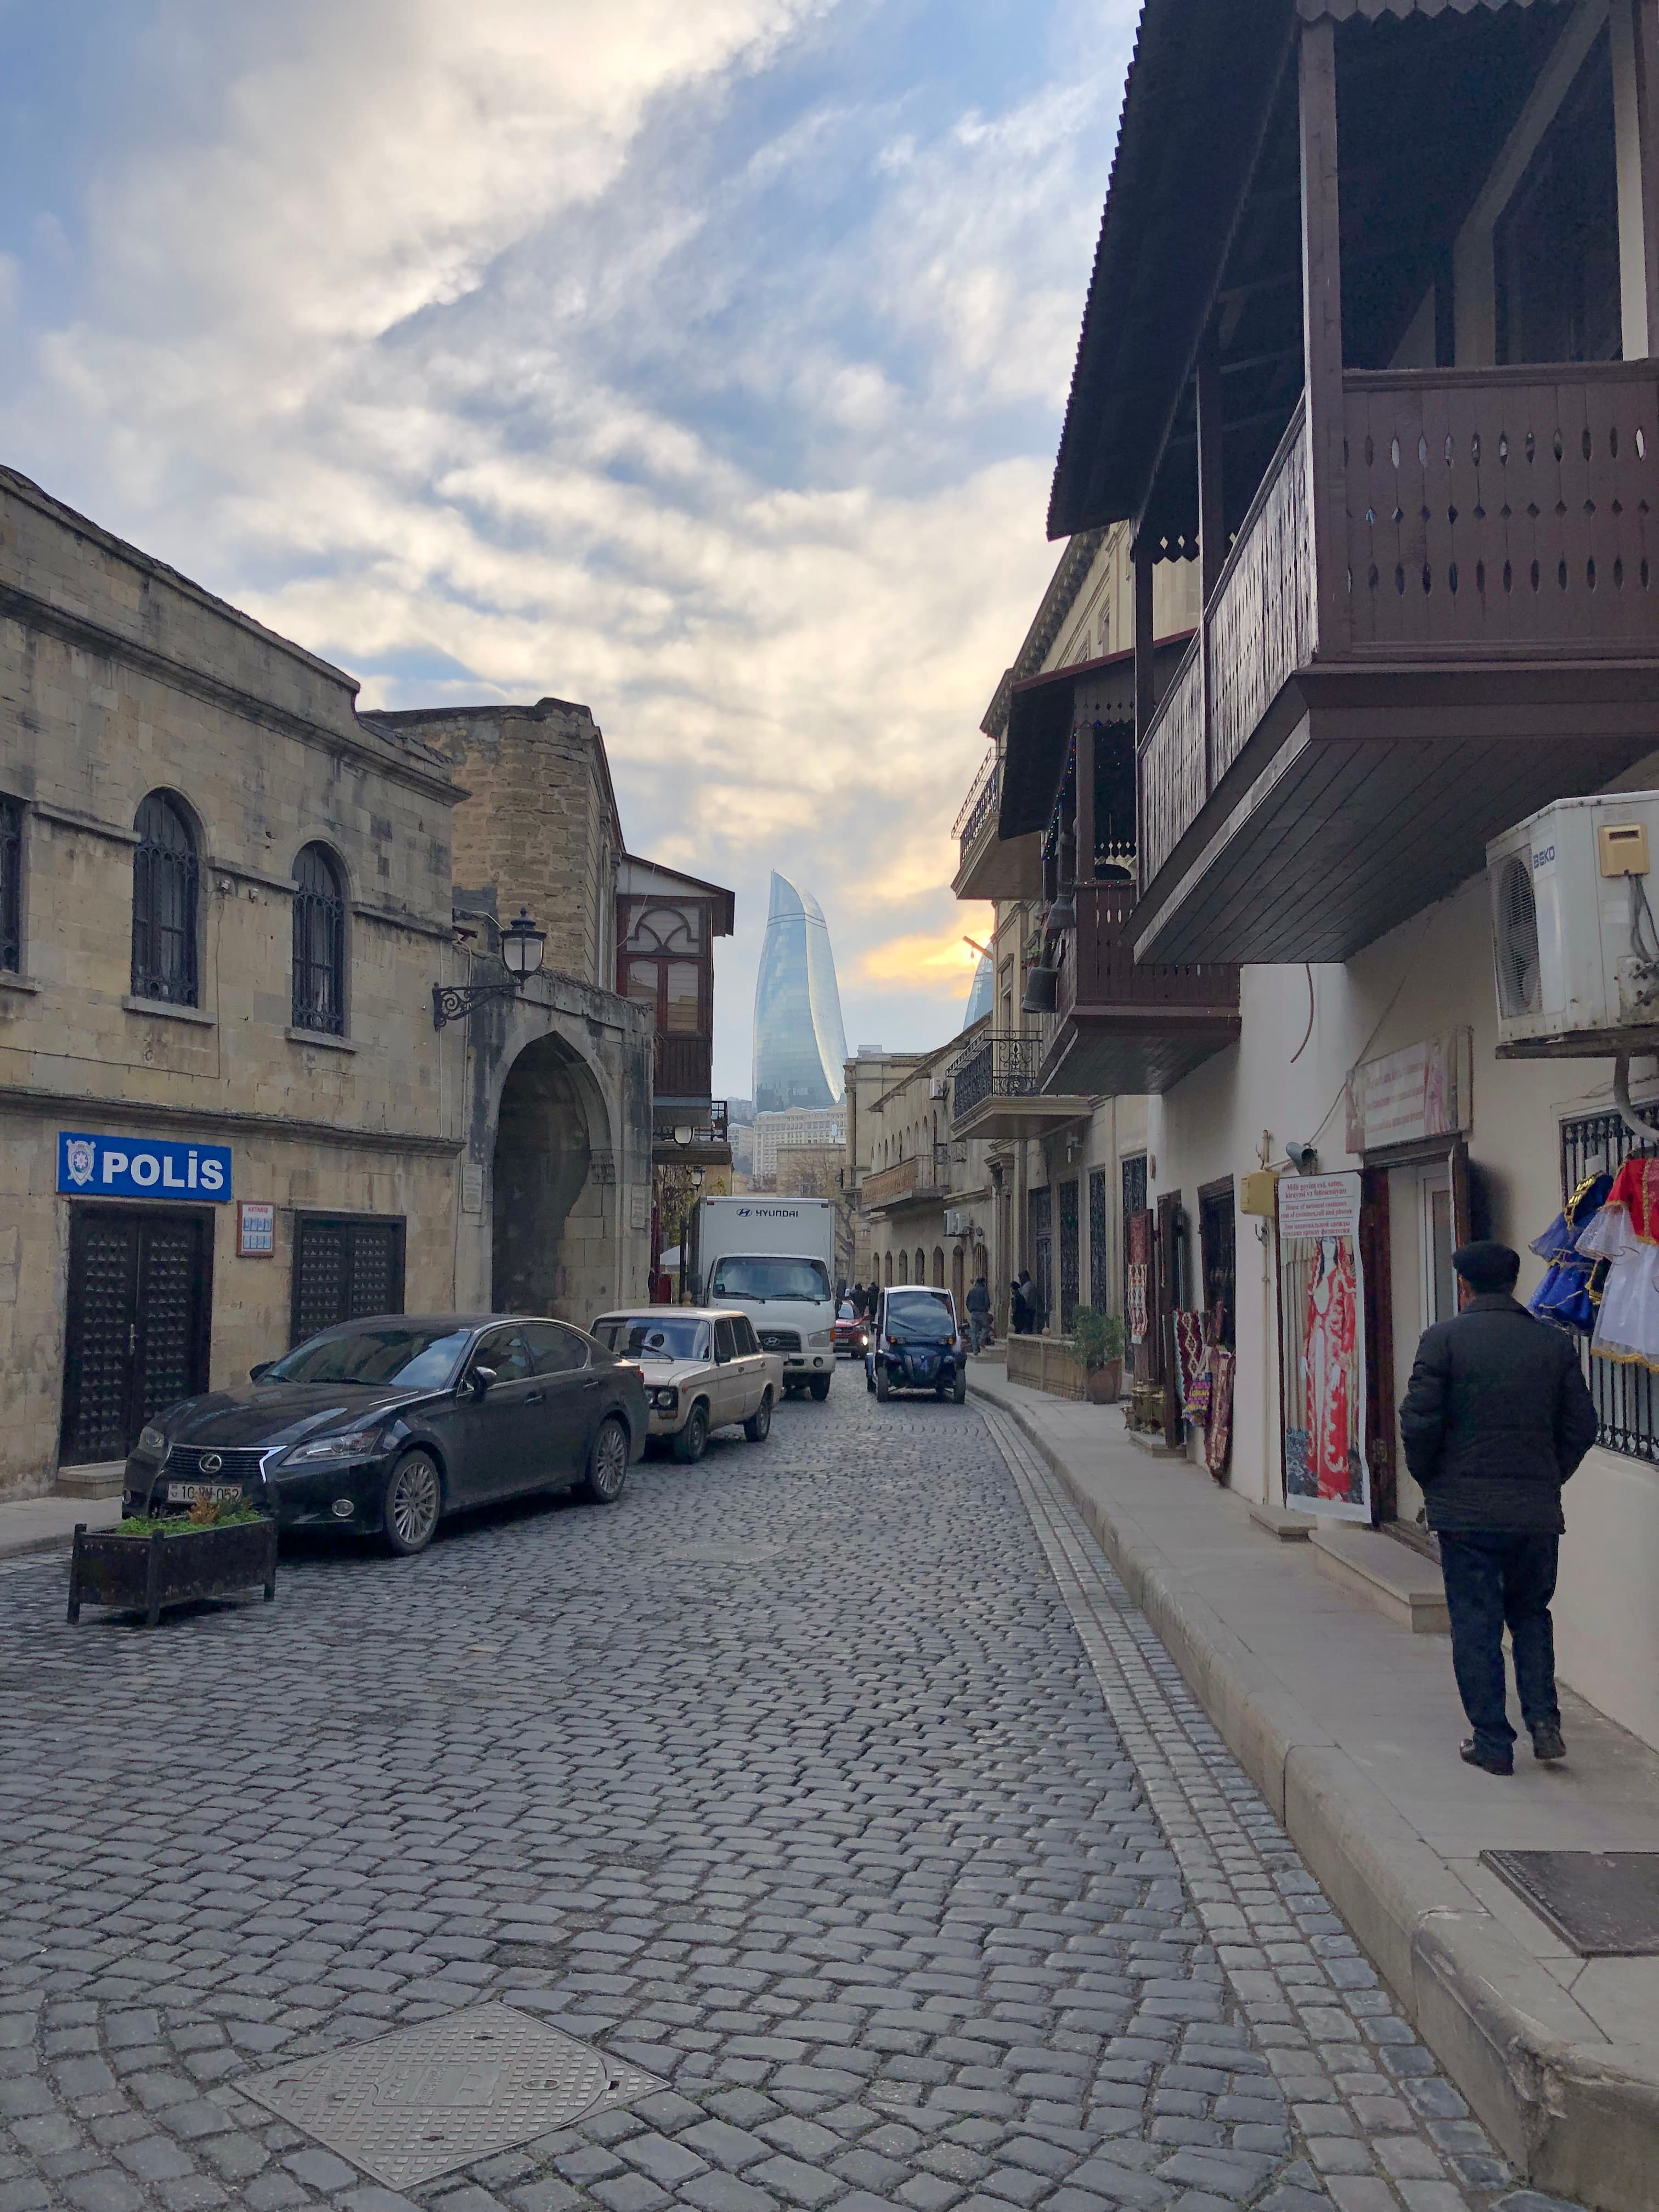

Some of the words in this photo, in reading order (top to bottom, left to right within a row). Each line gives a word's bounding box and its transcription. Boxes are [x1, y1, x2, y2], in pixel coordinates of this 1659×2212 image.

[1533, 846, 1555, 869] BEKO
[103, 1150, 224, 1189] POLİS
[755, 1209, 798, 1217] HYUNDAI
